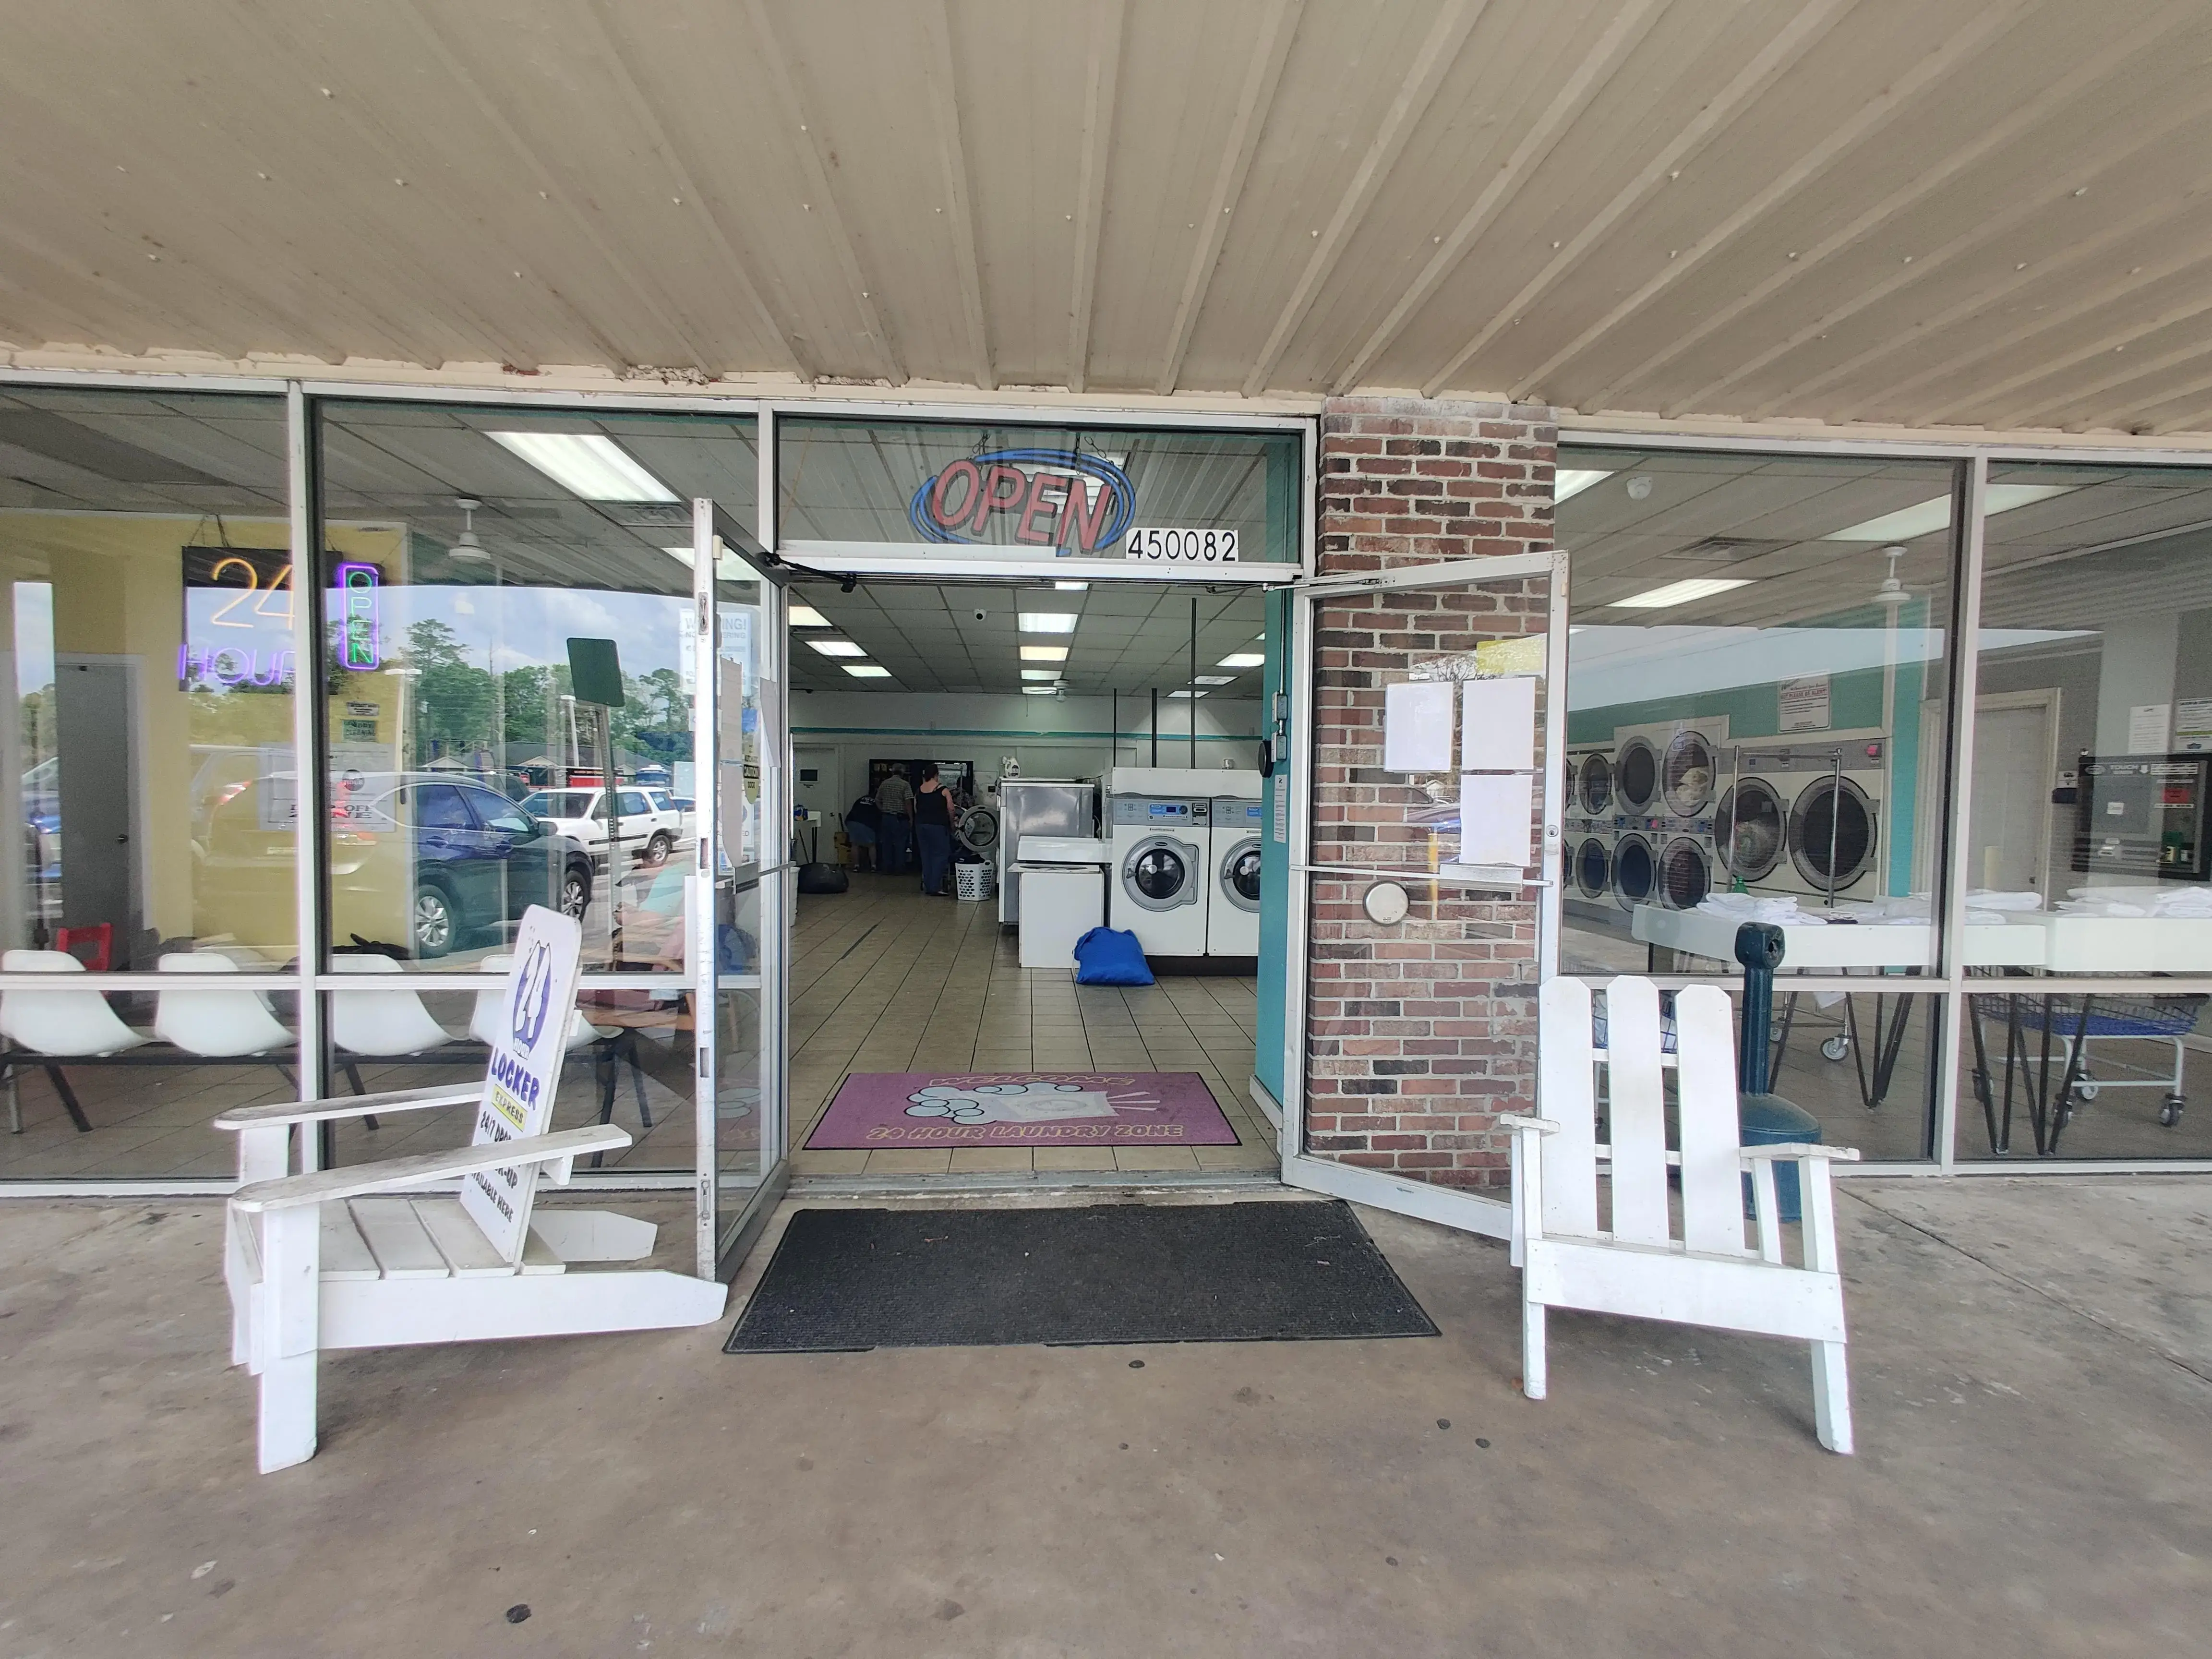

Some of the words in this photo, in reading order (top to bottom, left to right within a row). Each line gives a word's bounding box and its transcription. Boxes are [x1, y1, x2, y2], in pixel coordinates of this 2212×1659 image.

[931, 459, 1113, 553] OPEN
[1128, 530, 1237, 561] 450082
[211, 557, 294, 630] 24
[348, 571, 373, 664] OPEN
[491, 1046, 540, 1111] LOCKER
[929, 1075, 1136, 1086] WELCOME
[495, 1091, 524, 1124] EXPRESS
[480, 1110, 495, 1138] 24/7
[866, 1127, 905, 1140] 24
[908, 1126, 986, 1139] HOUR
[989, 1125, 1111, 1138] LAUNDRY
[1114, 1124, 1184, 1137] ZONE
[497, 1195, 514, 1223] HERE
